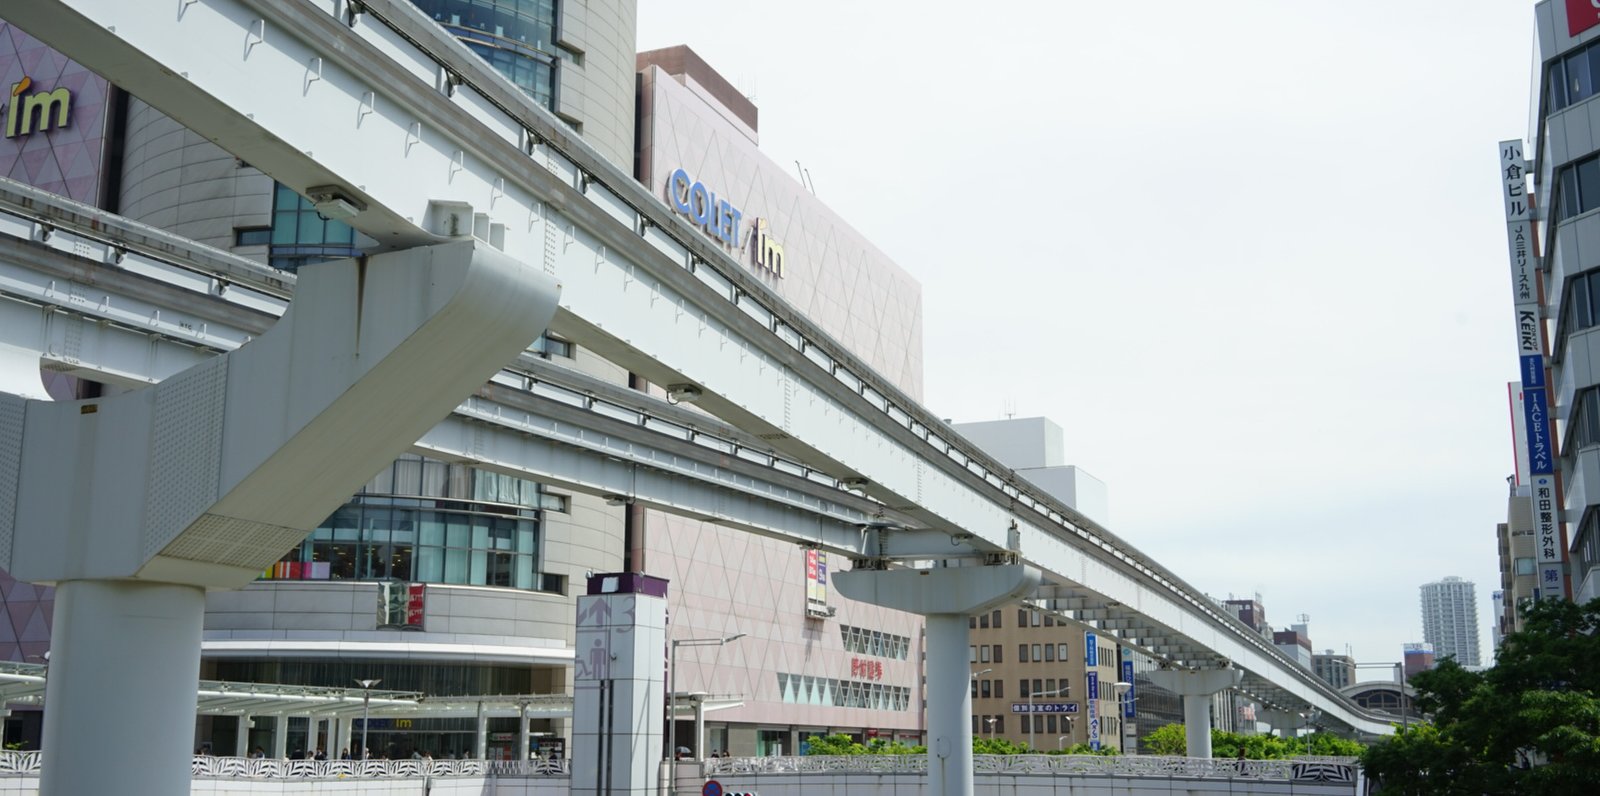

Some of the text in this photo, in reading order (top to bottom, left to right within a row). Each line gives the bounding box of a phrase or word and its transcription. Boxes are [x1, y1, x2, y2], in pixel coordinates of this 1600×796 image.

[667, 167, 742, 249] COLET
[1503, 145, 1527, 216] 小倉ビル
[1514, 224, 1531, 300] JA三井リース九州
[1519, 310, 1537, 351] KEIKI
[1531, 392, 1548, 471] IACEトラベル
[1538, 487, 1556, 560] 和田整形外科
